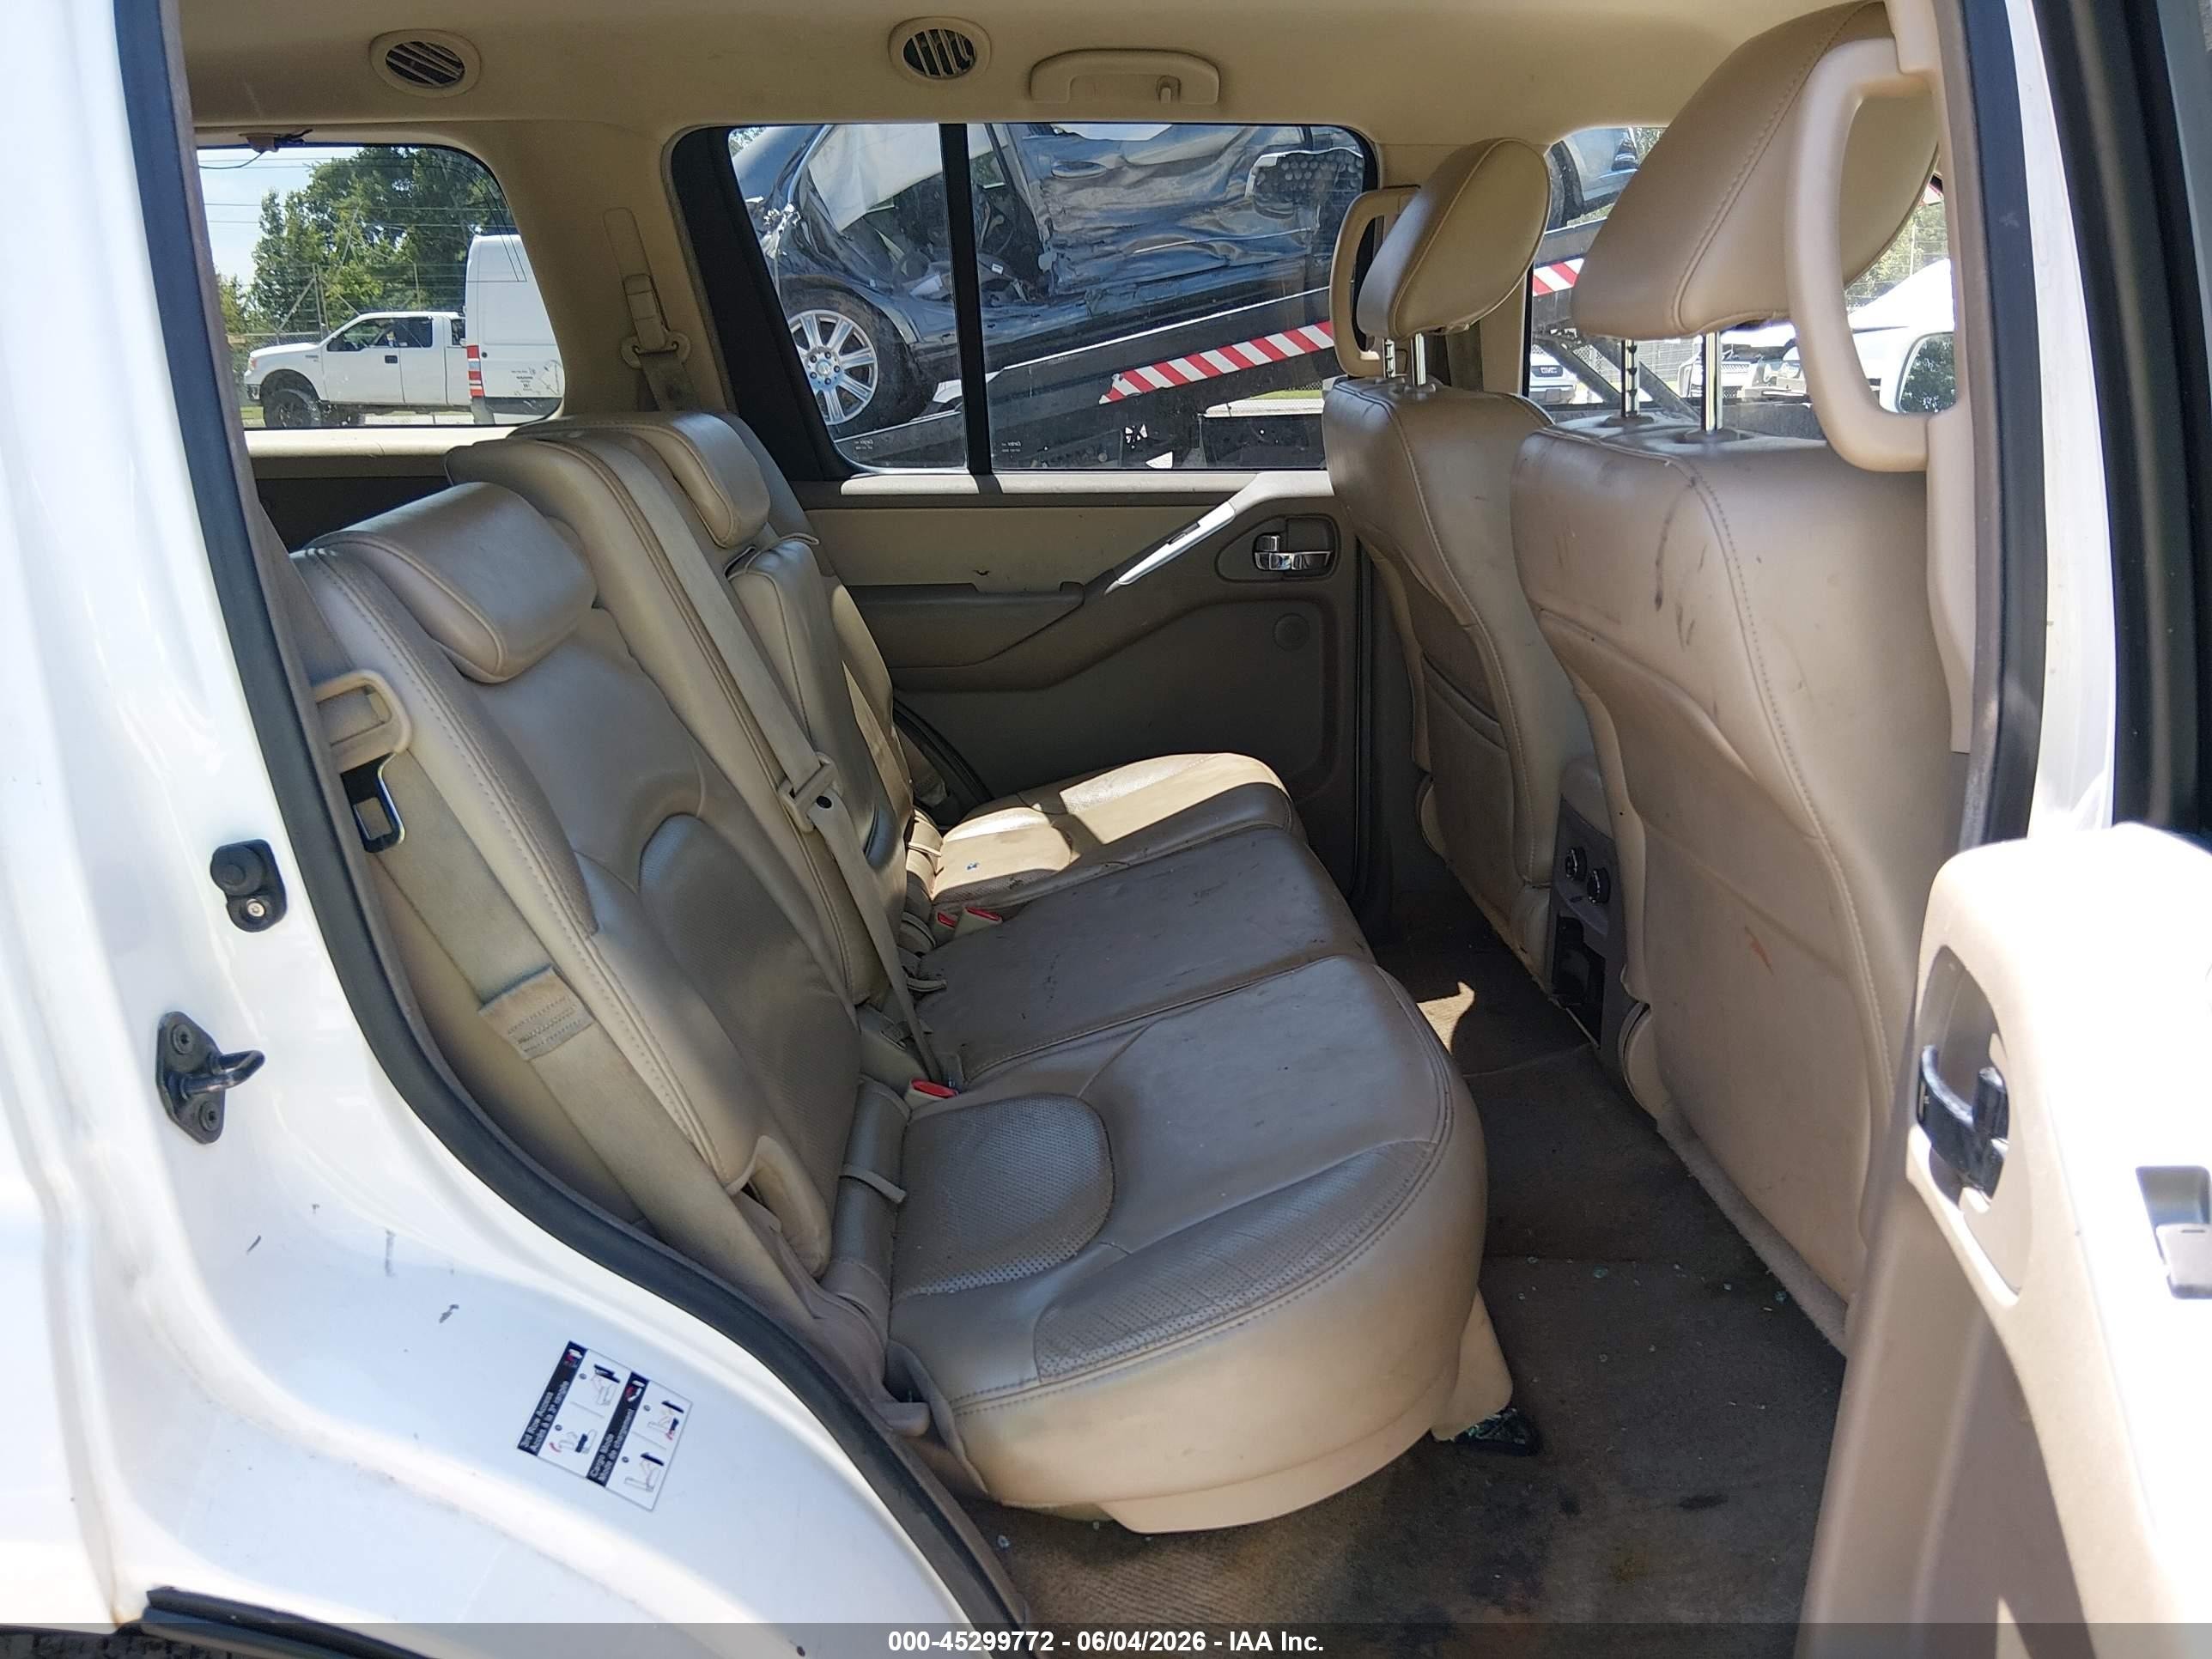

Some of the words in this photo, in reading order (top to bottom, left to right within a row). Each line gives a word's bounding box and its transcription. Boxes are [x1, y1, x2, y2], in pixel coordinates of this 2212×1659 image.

[527, 1417, 541, 1433] Row
[537, 1391, 553, 1416] Access
[589, 1453, 606, 1477] Cargo
[600, 1433, 614, 1454] Mode
[598, 1460, 612, 1480] Mode
[608, 1449, 617, 1460] de
[613, 1409, 635, 1449] chargement
